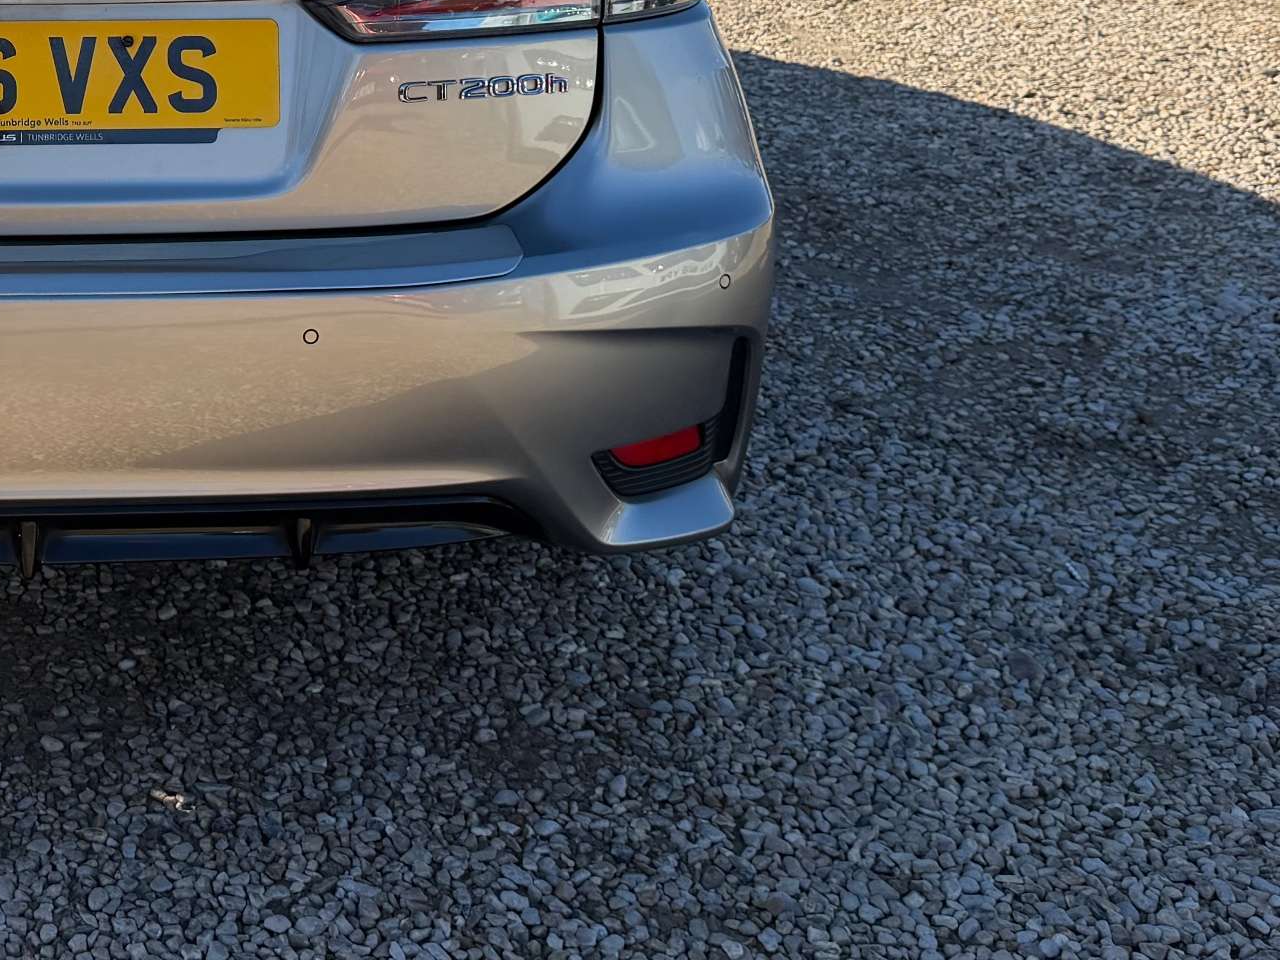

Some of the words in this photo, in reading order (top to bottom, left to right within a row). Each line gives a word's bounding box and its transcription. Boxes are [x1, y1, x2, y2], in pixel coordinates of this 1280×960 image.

[48, 35, 218, 115] VXS
[44, 118, 69, 127] Wells
[27, 132, 74, 142] TUNBRIDGE
[75, 132, 104, 141] WELLS
